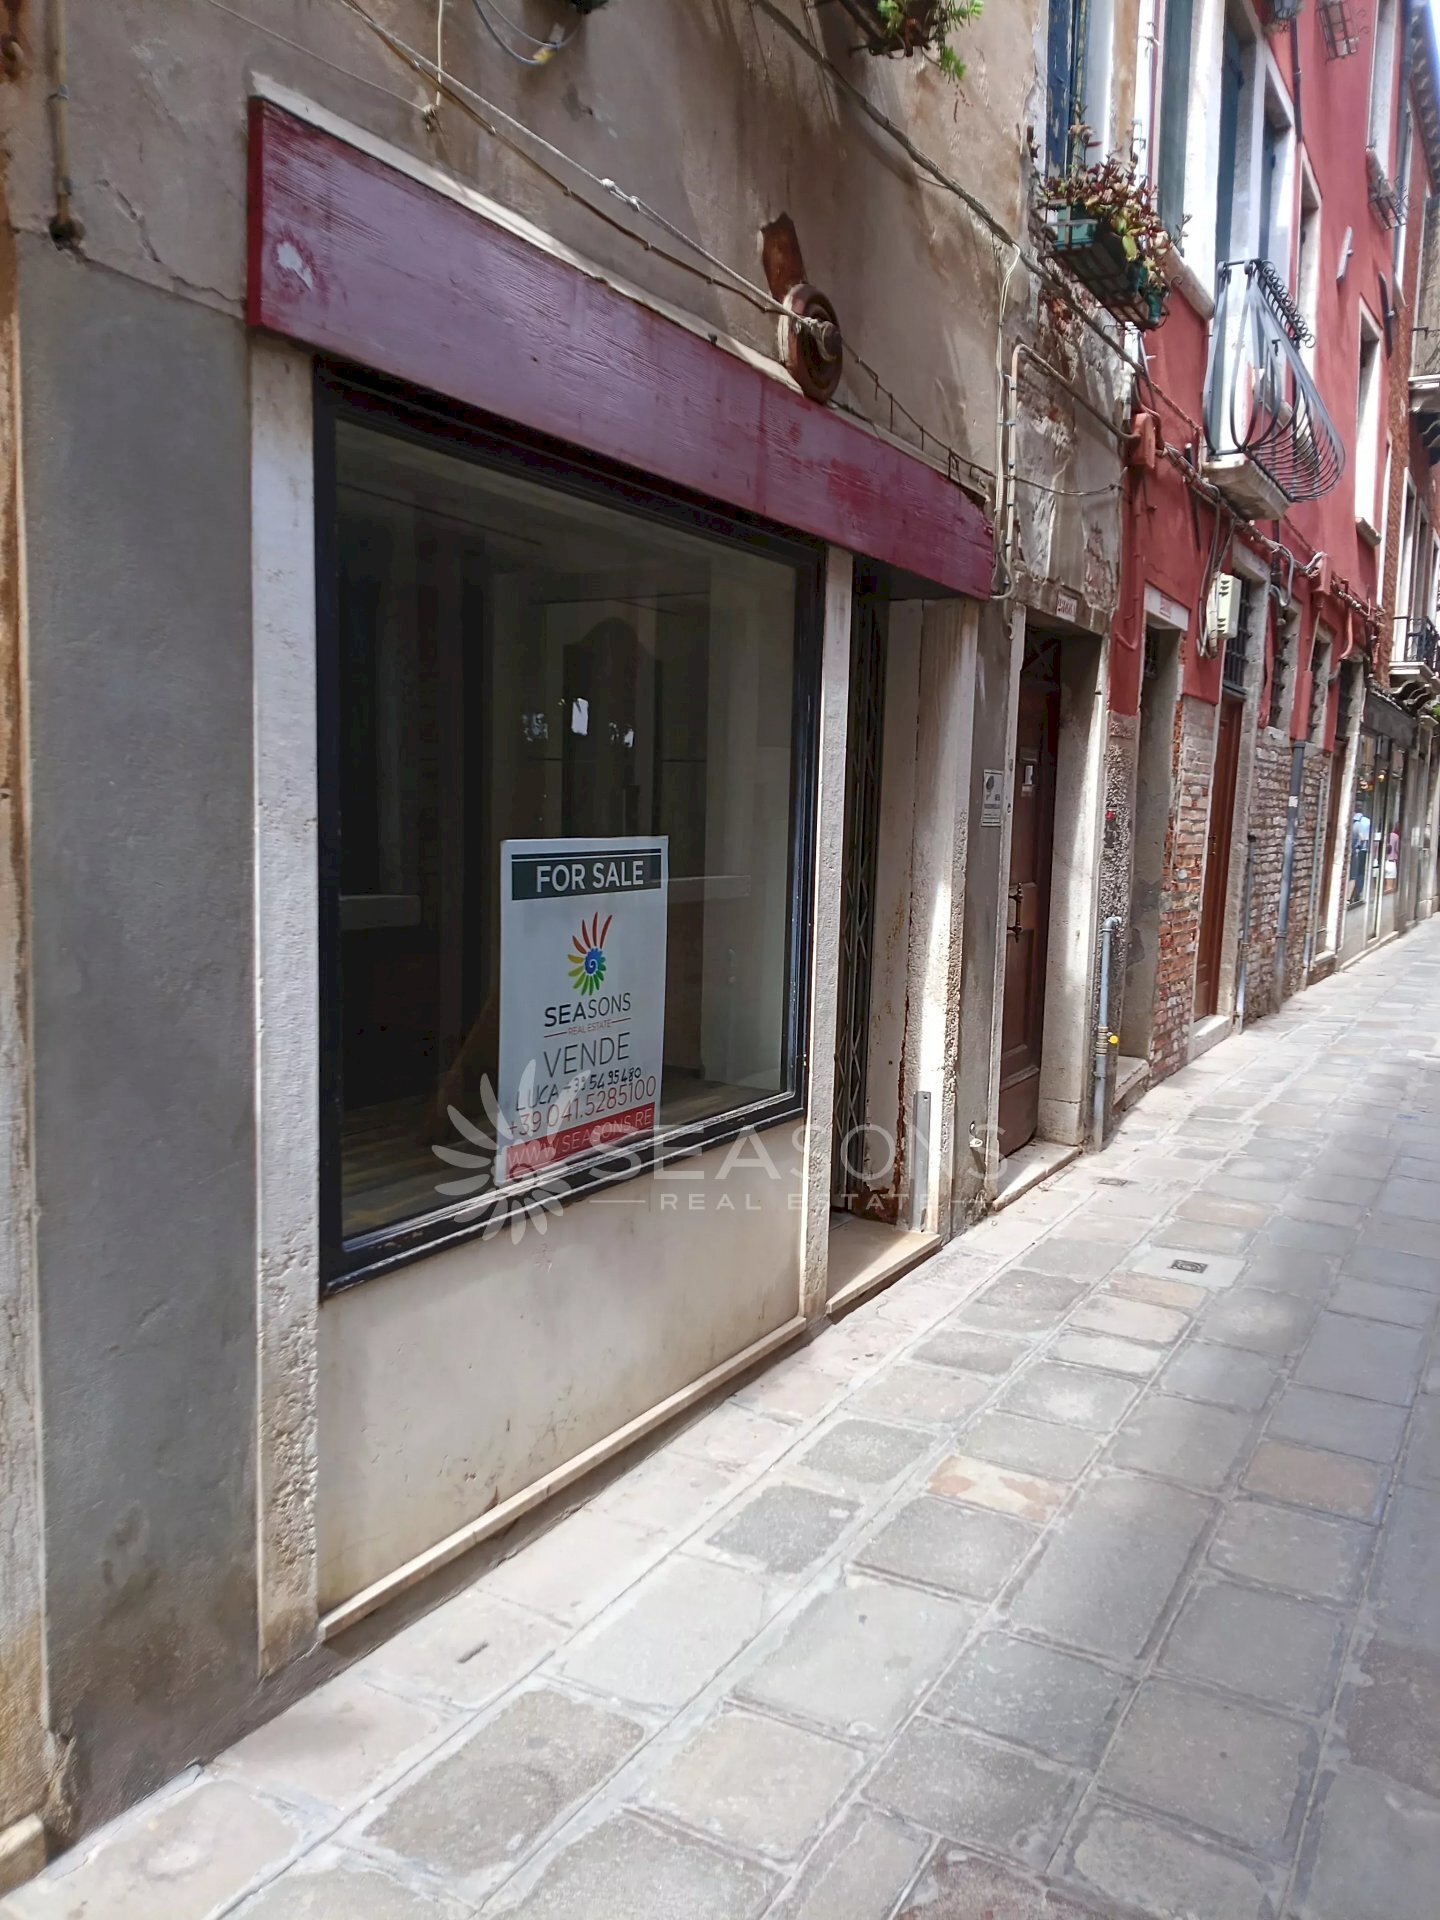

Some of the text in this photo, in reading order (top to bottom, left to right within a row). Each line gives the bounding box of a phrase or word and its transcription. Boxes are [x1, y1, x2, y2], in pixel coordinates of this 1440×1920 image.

[536, 861, 644, 893] FOR SALE
[544, 992, 631, 1028] SEASONS
[543, 1032, 631, 1078] VENDE
[515, 1083, 560, 1112] LUCA
